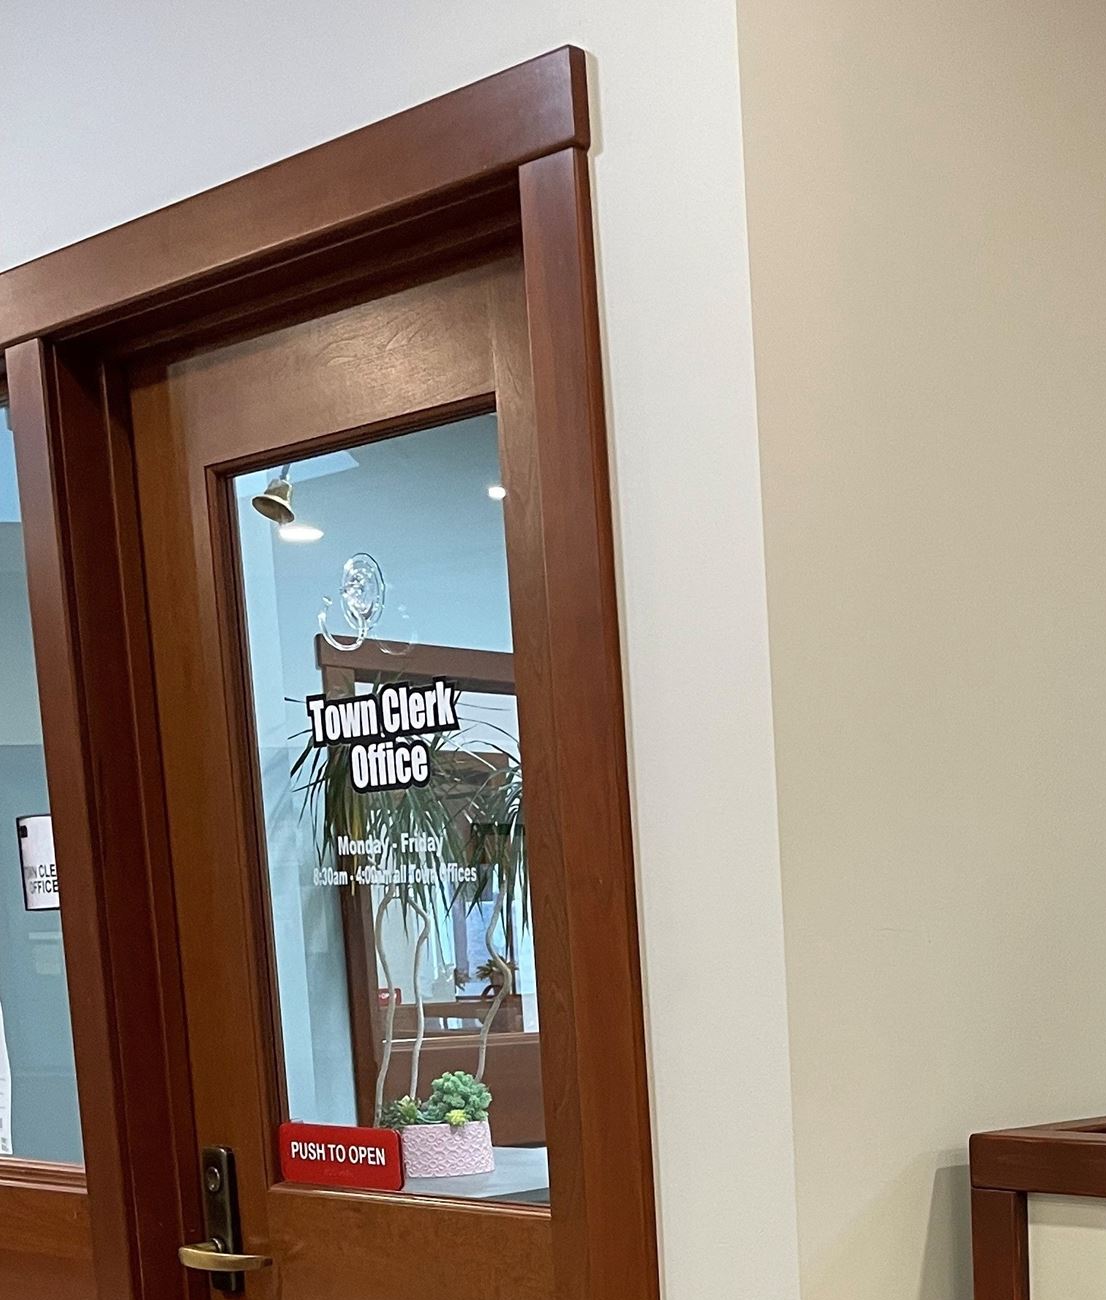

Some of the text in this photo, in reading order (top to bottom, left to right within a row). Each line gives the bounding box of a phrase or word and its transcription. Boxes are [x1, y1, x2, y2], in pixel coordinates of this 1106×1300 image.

[309, 681, 456, 743] Town Clerk
[352, 743, 428, 789] Office
[337, 832, 443, 857] Monday Friday
[38, 864, 57, 878] CLE
[313, 867, 348, 886] 8:30am
[393, 864, 406, 884] all
[408, 863, 436, 884] Town
[439, 862, 477, 882] Offices
[290, 1141, 386, 1166] PUSH TO OPEN
